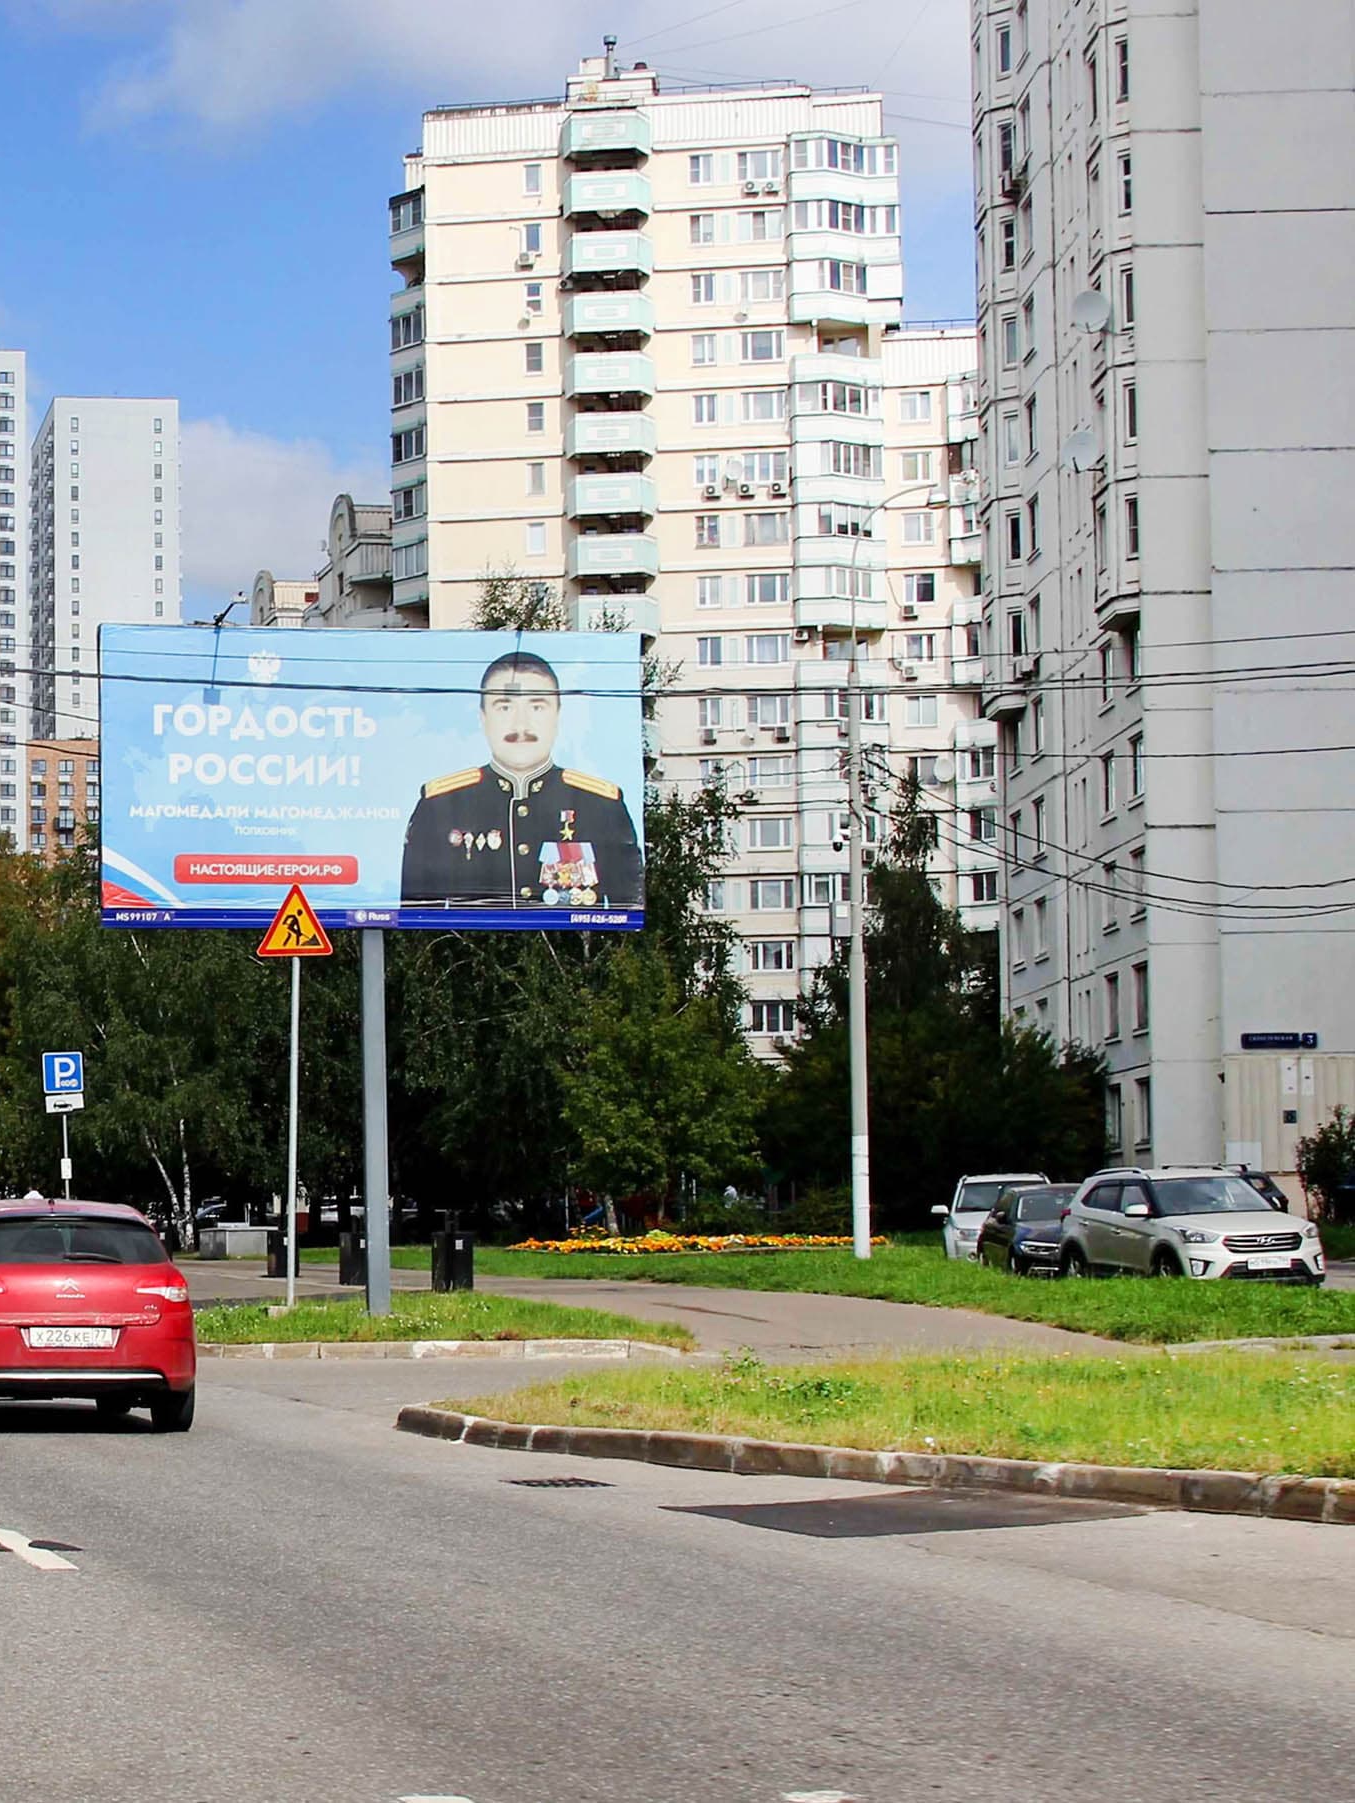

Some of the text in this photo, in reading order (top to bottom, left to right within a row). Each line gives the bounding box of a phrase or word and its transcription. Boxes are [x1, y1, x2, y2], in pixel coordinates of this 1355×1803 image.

[153, 704, 378, 741] ГОРДОСТЬ
[168, 753, 362, 786] РОССИИ!
[129, 804, 402, 820] МАГОМЕДАЛИ МАГОМЕДЖАНОВ
[189, 863, 343, 877] НАСТОЯЩИЕ-ГЕРОИ.РФ
[368, 912, 391, 921] Russ
[1306, 1034, 1314, 1045] 3
[53, 1057, 76, 1088] P
